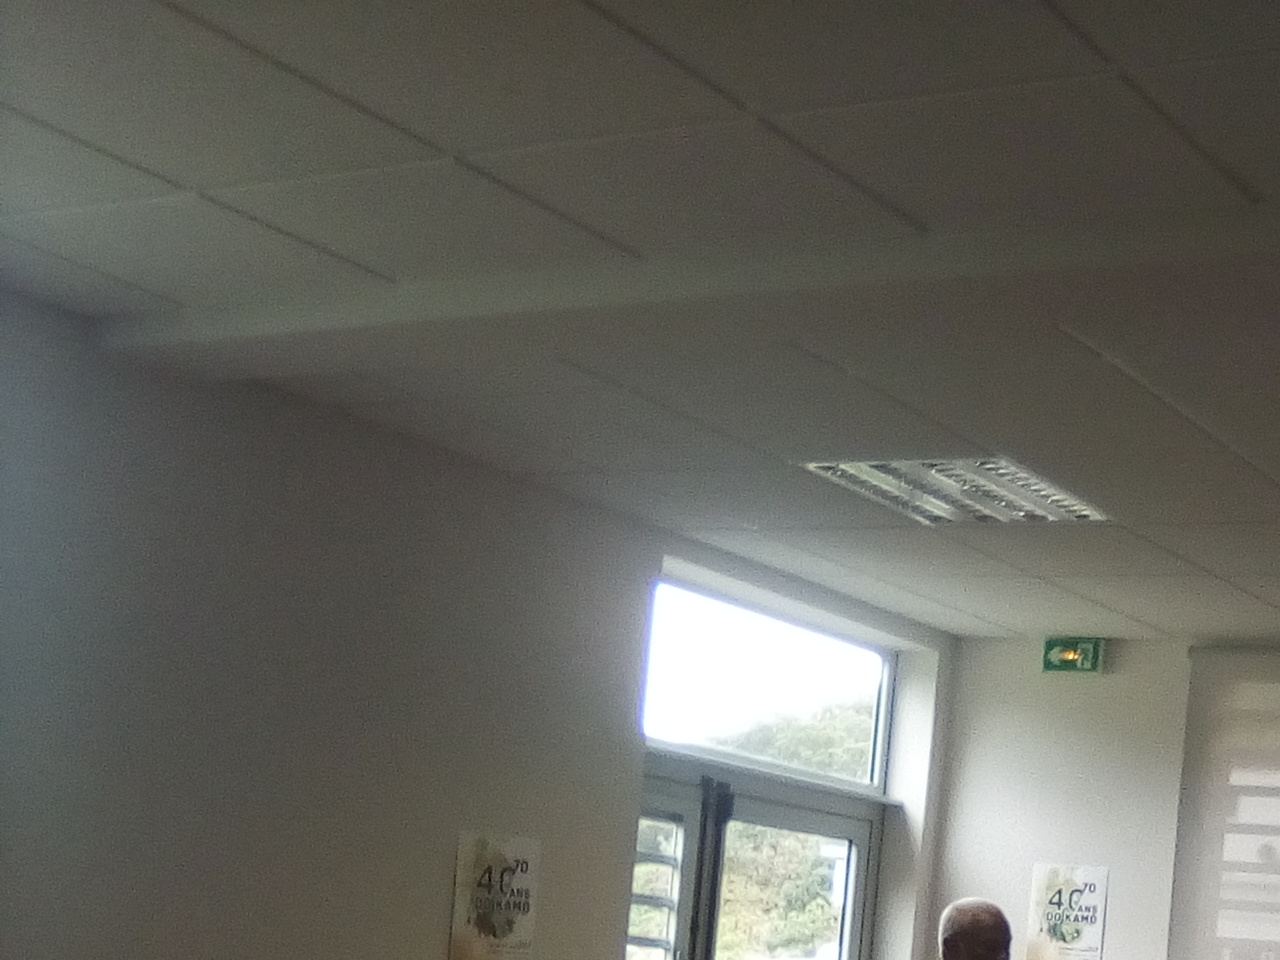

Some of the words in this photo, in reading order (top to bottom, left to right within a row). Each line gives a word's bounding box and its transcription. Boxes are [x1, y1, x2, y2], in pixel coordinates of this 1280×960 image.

[1077, 905, 1098, 914] ANS
[1046, 912, 1061, 922] DO
[1065, 914, 1097, 925] KAMO
